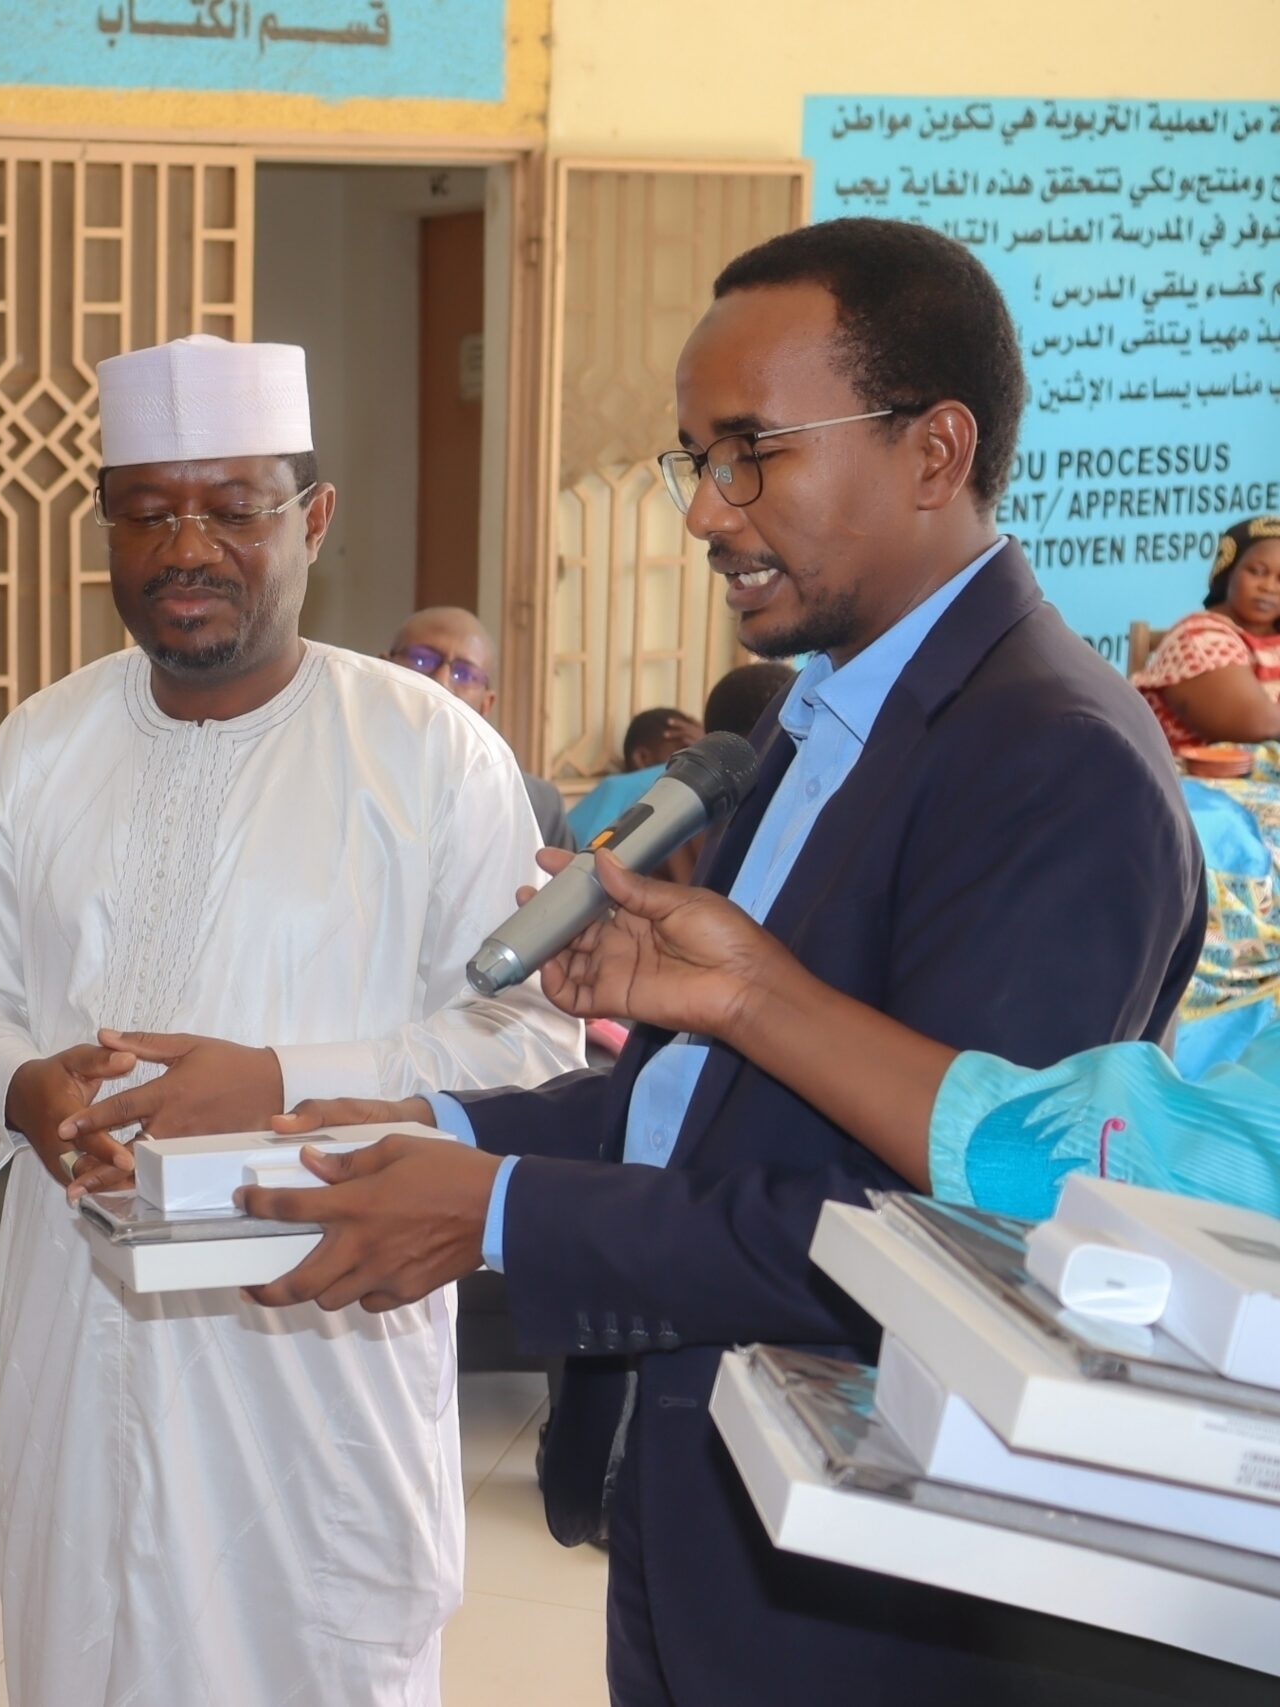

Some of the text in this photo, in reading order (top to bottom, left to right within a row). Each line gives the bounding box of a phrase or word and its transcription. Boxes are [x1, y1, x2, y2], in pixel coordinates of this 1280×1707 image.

[832, 103, 912, 139] مواطن
[920, 103, 995, 141] تكوين
[1001, 107, 1037, 146] هي
[1044, 100, 1141, 142] التربوية
[1147, 102, 1228, 141] العملية
[1233, 110, 1263, 141] من
[835, 175, 890, 205] يجب
[900, 166, 979, 207] الغاية
[986, 168, 1034, 196] هذه
[1040, 166, 1122, 203] تتحقق
[1004, 217, 1104, 252] العناصر
[1110, 211, 1194, 248] المدرسة
[1200, 212, 1226, 256] في
[1051, 272, 1136, 307] الدرس
[1141, 270, 1198, 313] يلقي
[1031, 322, 1115, 356] الدرس
[1119, 375, 1192, 410] يساعد
[1197, 371, 1263, 406] مناسب
[1057, 442, 1231, 480] PROCESSUS
[1135, 530, 1224, 564] RESPO
